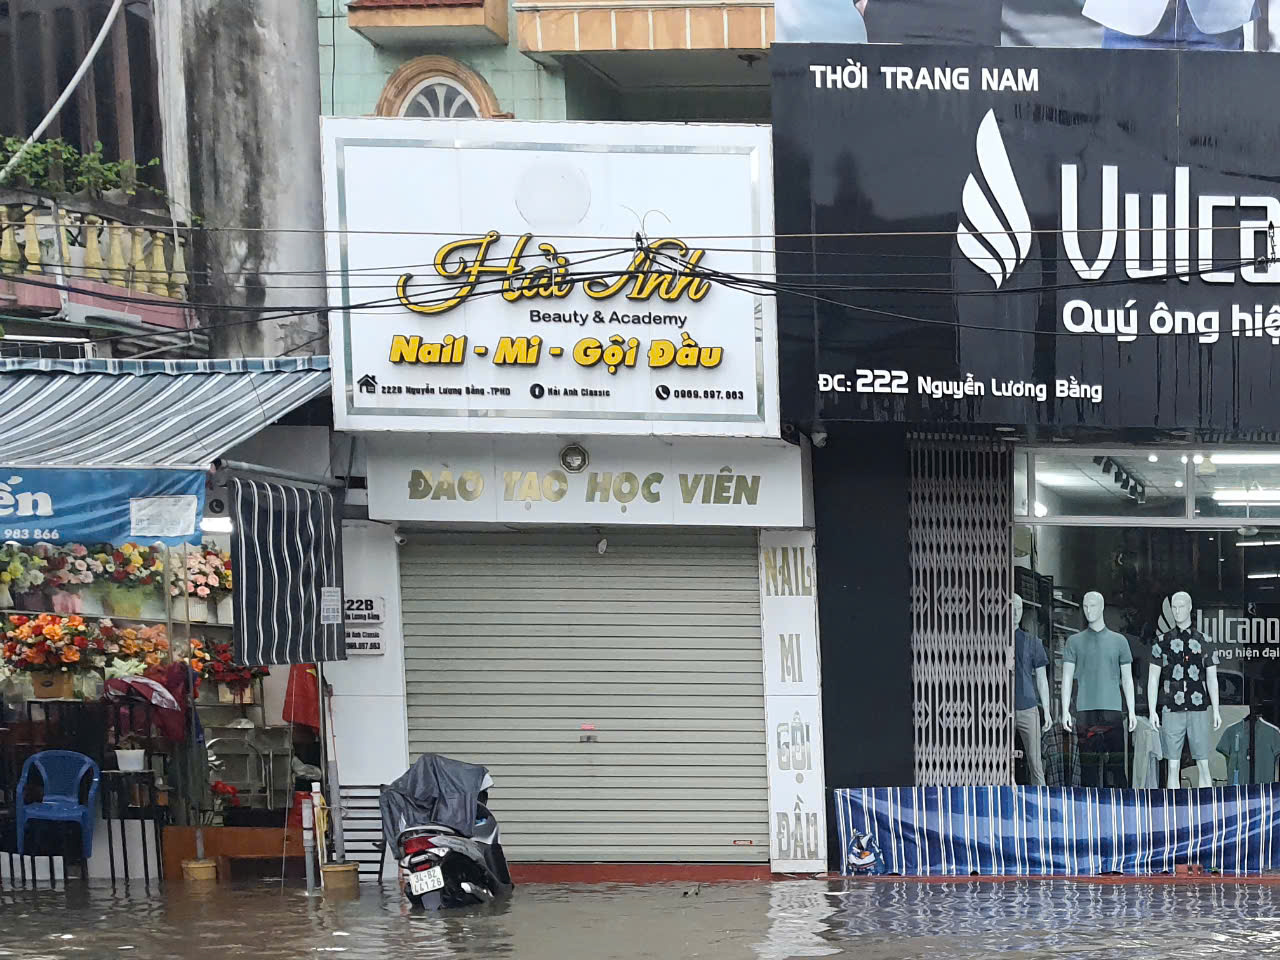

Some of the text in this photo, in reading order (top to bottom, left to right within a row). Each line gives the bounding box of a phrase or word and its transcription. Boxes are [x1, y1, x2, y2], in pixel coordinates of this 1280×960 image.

[809, 58, 1040, 92] THỜI TRANG NAM
[396, 230, 713, 315] Hải Anh
[529, 309, 687, 329] Beauty & Academy
[1062, 299, 1138, 342] Quý
[1149, 302, 1220, 344] ông
[389, 334, 467, 363] Nail
[493, 335, 543, 364] Mi
[573, 335, 640, 375] Gội
[648, 332, 724, 367] Đầu
[563, 387, 578, 397] Anh
[581, 388, 610, 397] Classic
[818, 369, 1103, 402] ĐC: 222 Nguyễn Lương Bằng
[407, 463, 762, 513] ĐÀO TẠO HỌC VIÊN
[4, 529, 59, 539] 983 866
[763, 547, 813, 596] NAIL
[345, 599, 374, 611] 22B
[779, 634, 804, 683] MI
[1235, 648, 1260, 661] hiện
[1262, 648, 1280, 660] đại
[776, 711, 813, 785] GỘI
